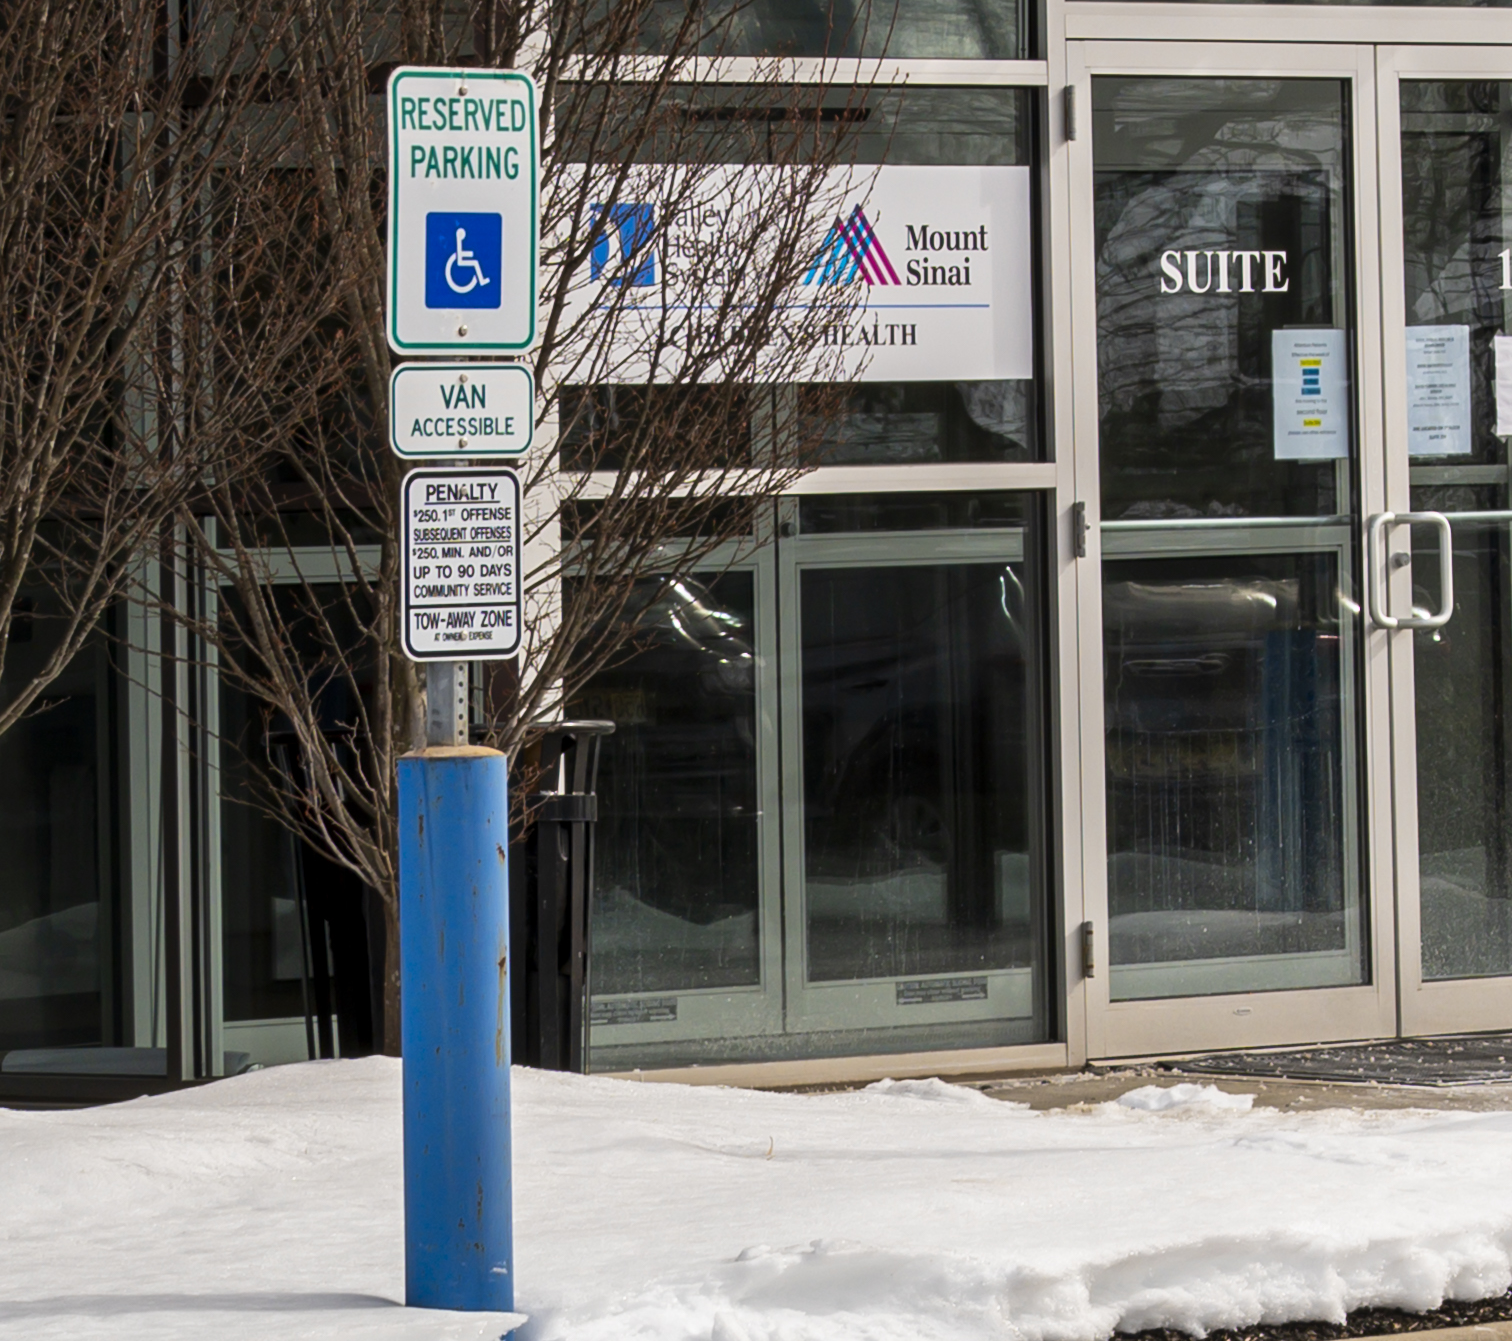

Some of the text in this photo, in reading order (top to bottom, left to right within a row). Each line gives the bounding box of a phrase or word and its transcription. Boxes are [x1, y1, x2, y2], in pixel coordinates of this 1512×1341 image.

[401, 97, 526, 132] RESERVED
[411, 145, 519, 180] PARKING
[905, 224, 988, 252] Mount
[906, 258, 971, 287] Sinai
[1160, 250, 1289, 294] SUITE
[822, 322, 917, 347] HEALTH
[440, 384, 486, 409] VAN
[411, 417, 514, 437] ACCESSIBLE
[426, 483, 498, 501] PENALTY
[461, 507, 512, 521] OFFENSE
[413, 526, 512, 541] SUBSEQUENT OFFENSES
[412, 545, 513, 559] $250. MIN. AND/OR
[413, 563, 512, 579] UP TO 90 DAYS
[414, 582, 512, 598] COMMUNITY SERVICE
[414, 610, 513, 630] TOW-AWAY ZONE
